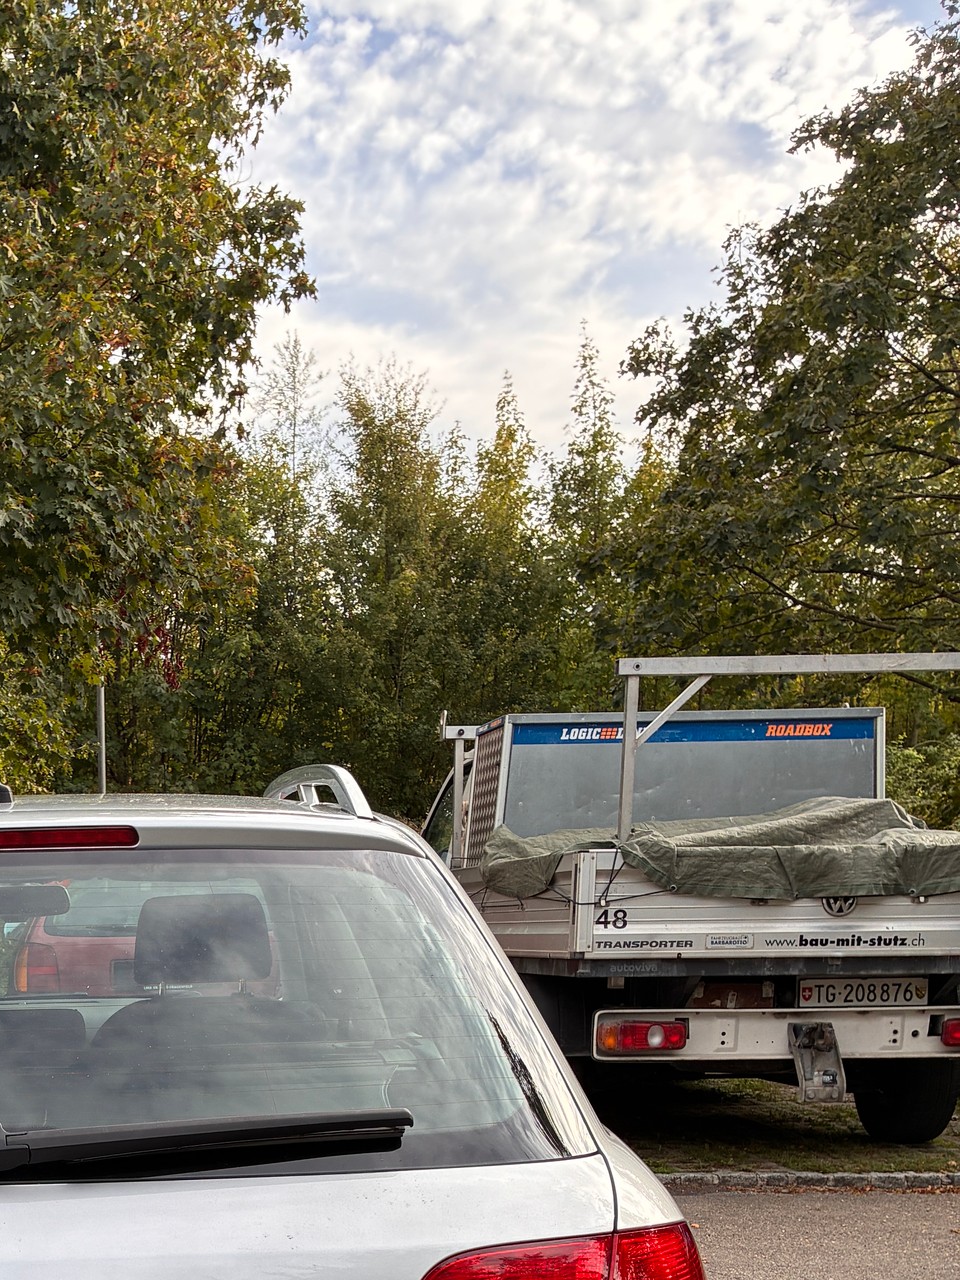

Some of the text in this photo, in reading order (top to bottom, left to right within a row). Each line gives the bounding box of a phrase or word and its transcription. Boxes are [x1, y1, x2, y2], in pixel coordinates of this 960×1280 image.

[765, 723, 833, 737] ROADBOX
[595, 909, 628, 930] 48
[595, 940, 694, 949] TRANSPORTER
[765, 933, 925, 948] www.bau-mit-stutz.ch
[609, 962, 658, 973] autoviva
